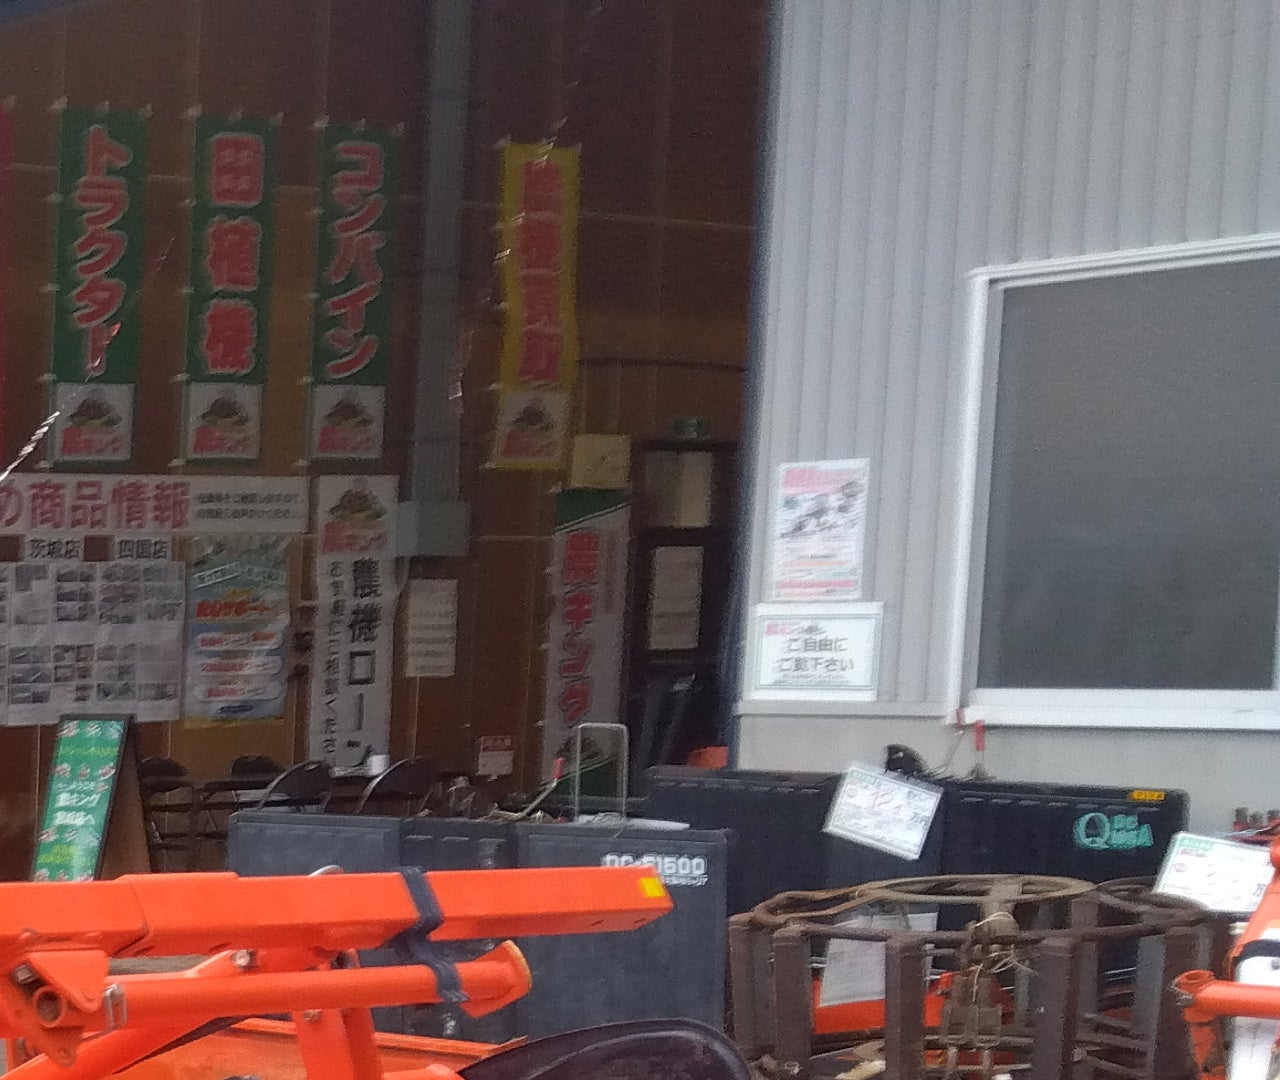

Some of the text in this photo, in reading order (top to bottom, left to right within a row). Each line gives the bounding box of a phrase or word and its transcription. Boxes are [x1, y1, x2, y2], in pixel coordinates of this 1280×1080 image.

[73, 123, 133, 375] トラクター
[323, 142, 386, 378] コンバイン
[776, 657, 854, 672] ご覧下さい
[786, 636, 848, 652] ご自由に
